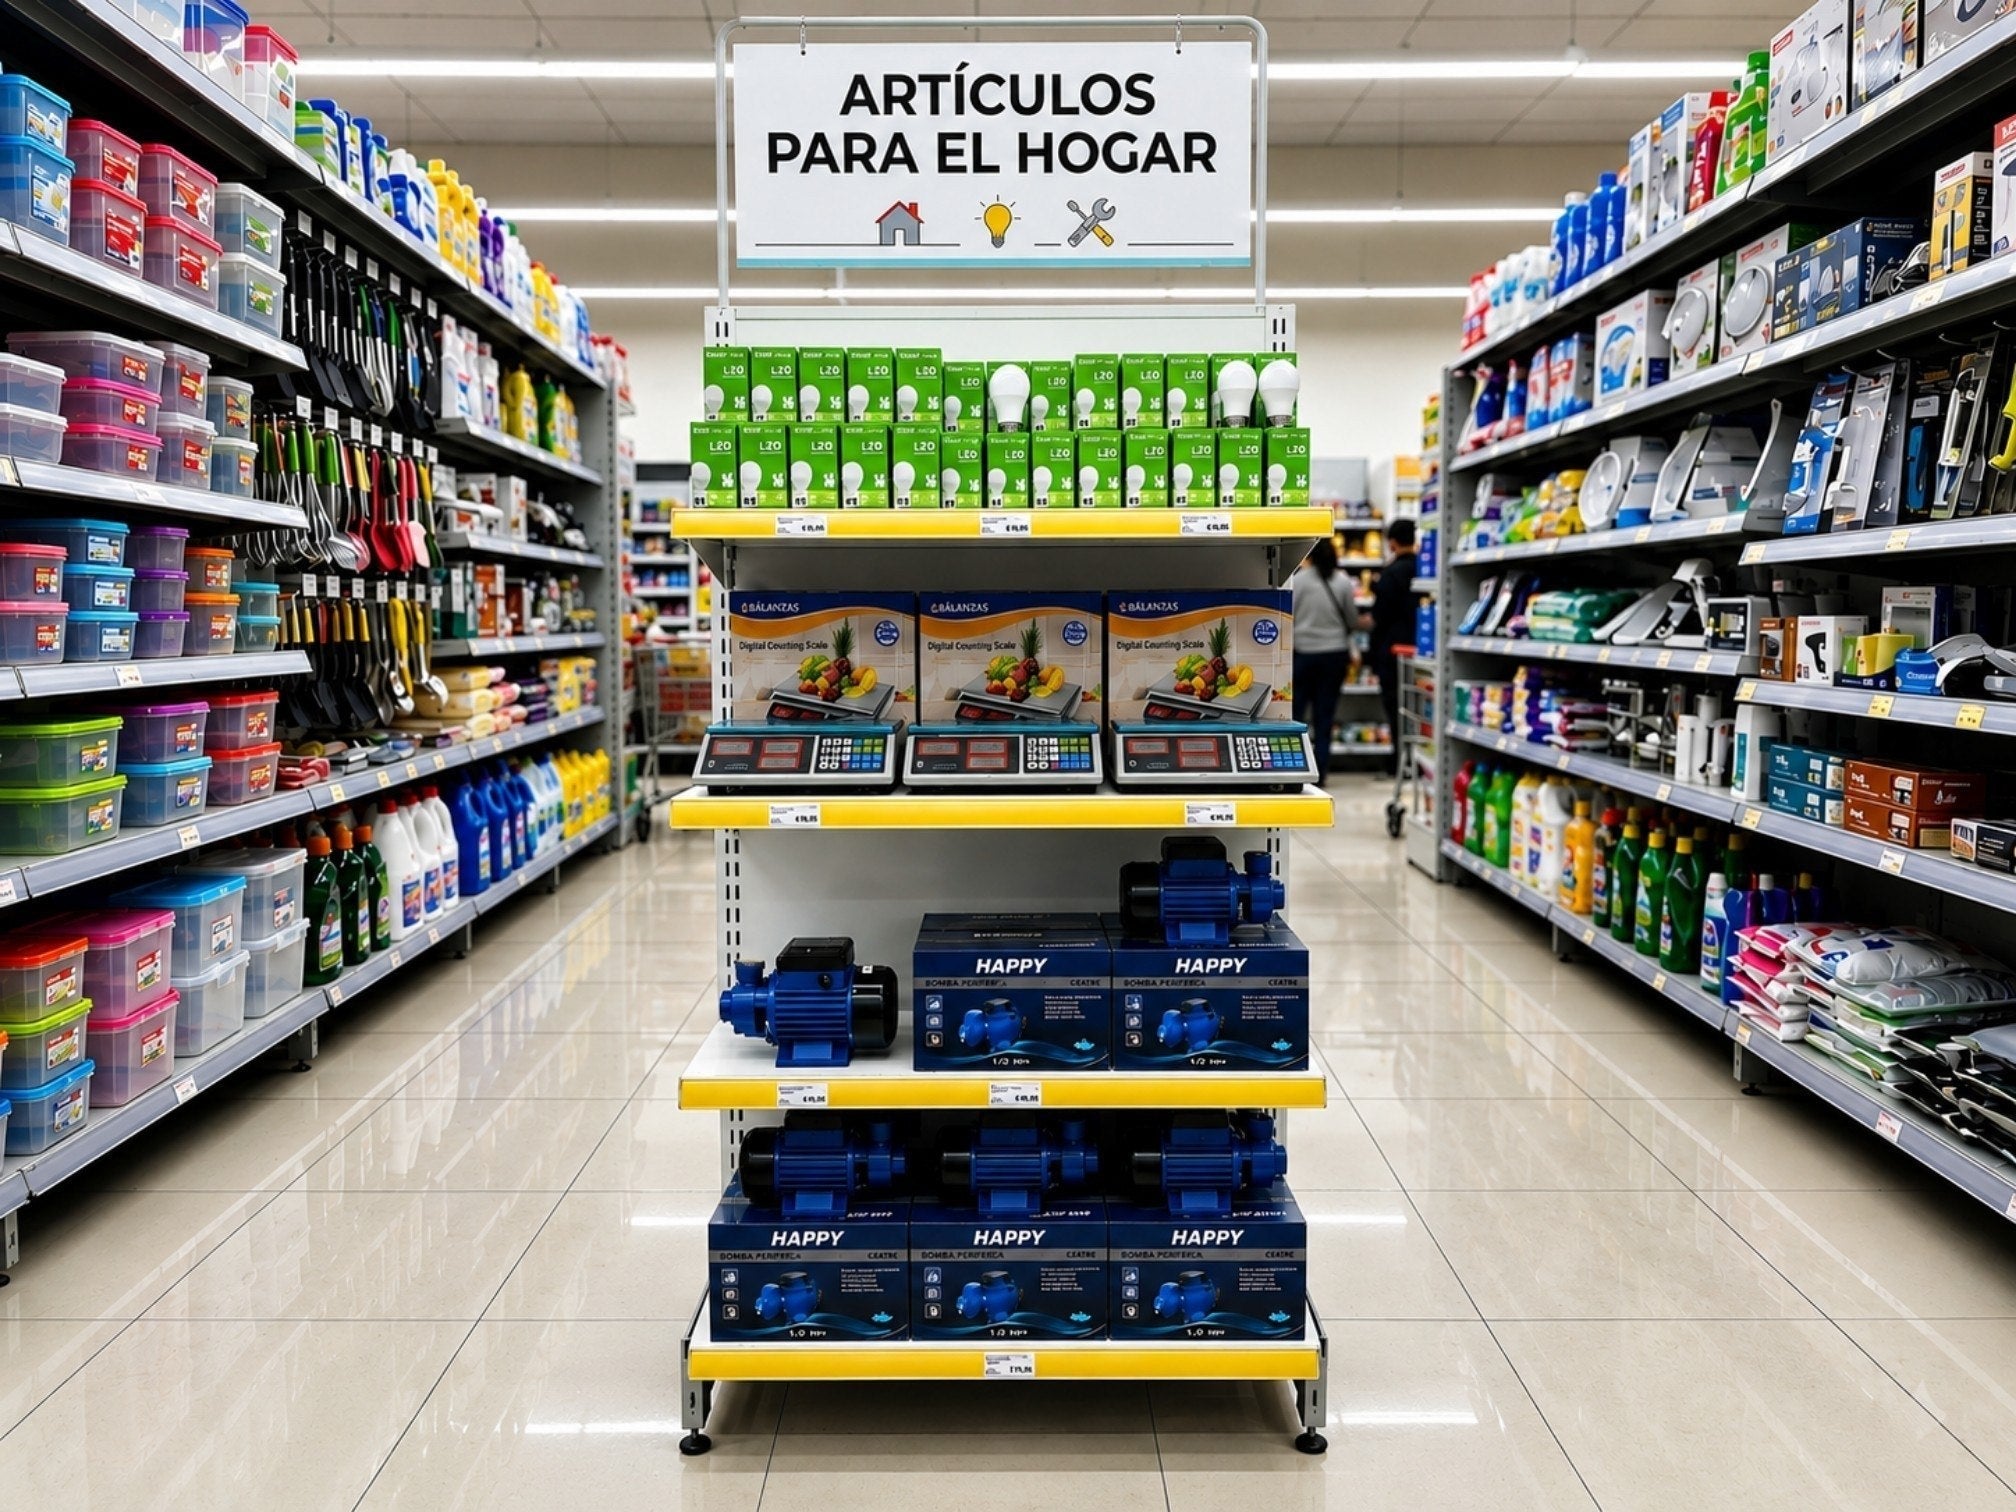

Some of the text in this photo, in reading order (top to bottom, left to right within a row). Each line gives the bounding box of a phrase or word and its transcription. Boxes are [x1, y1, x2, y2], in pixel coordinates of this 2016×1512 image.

[839, 61, 1156, 116] ARTÍCULOS
[768, 130, 1217, 174] PARA EL HOGAR
[975, 958, 1048, 974] HAPPY
[1175, 958, 1248, 974] HAPPY
[771, 1231, 845, 1247] HAPPY
[973, 1230, 1046, 1246] HAPPY
[1171, 1230, 1245, 1246] HAPPY
